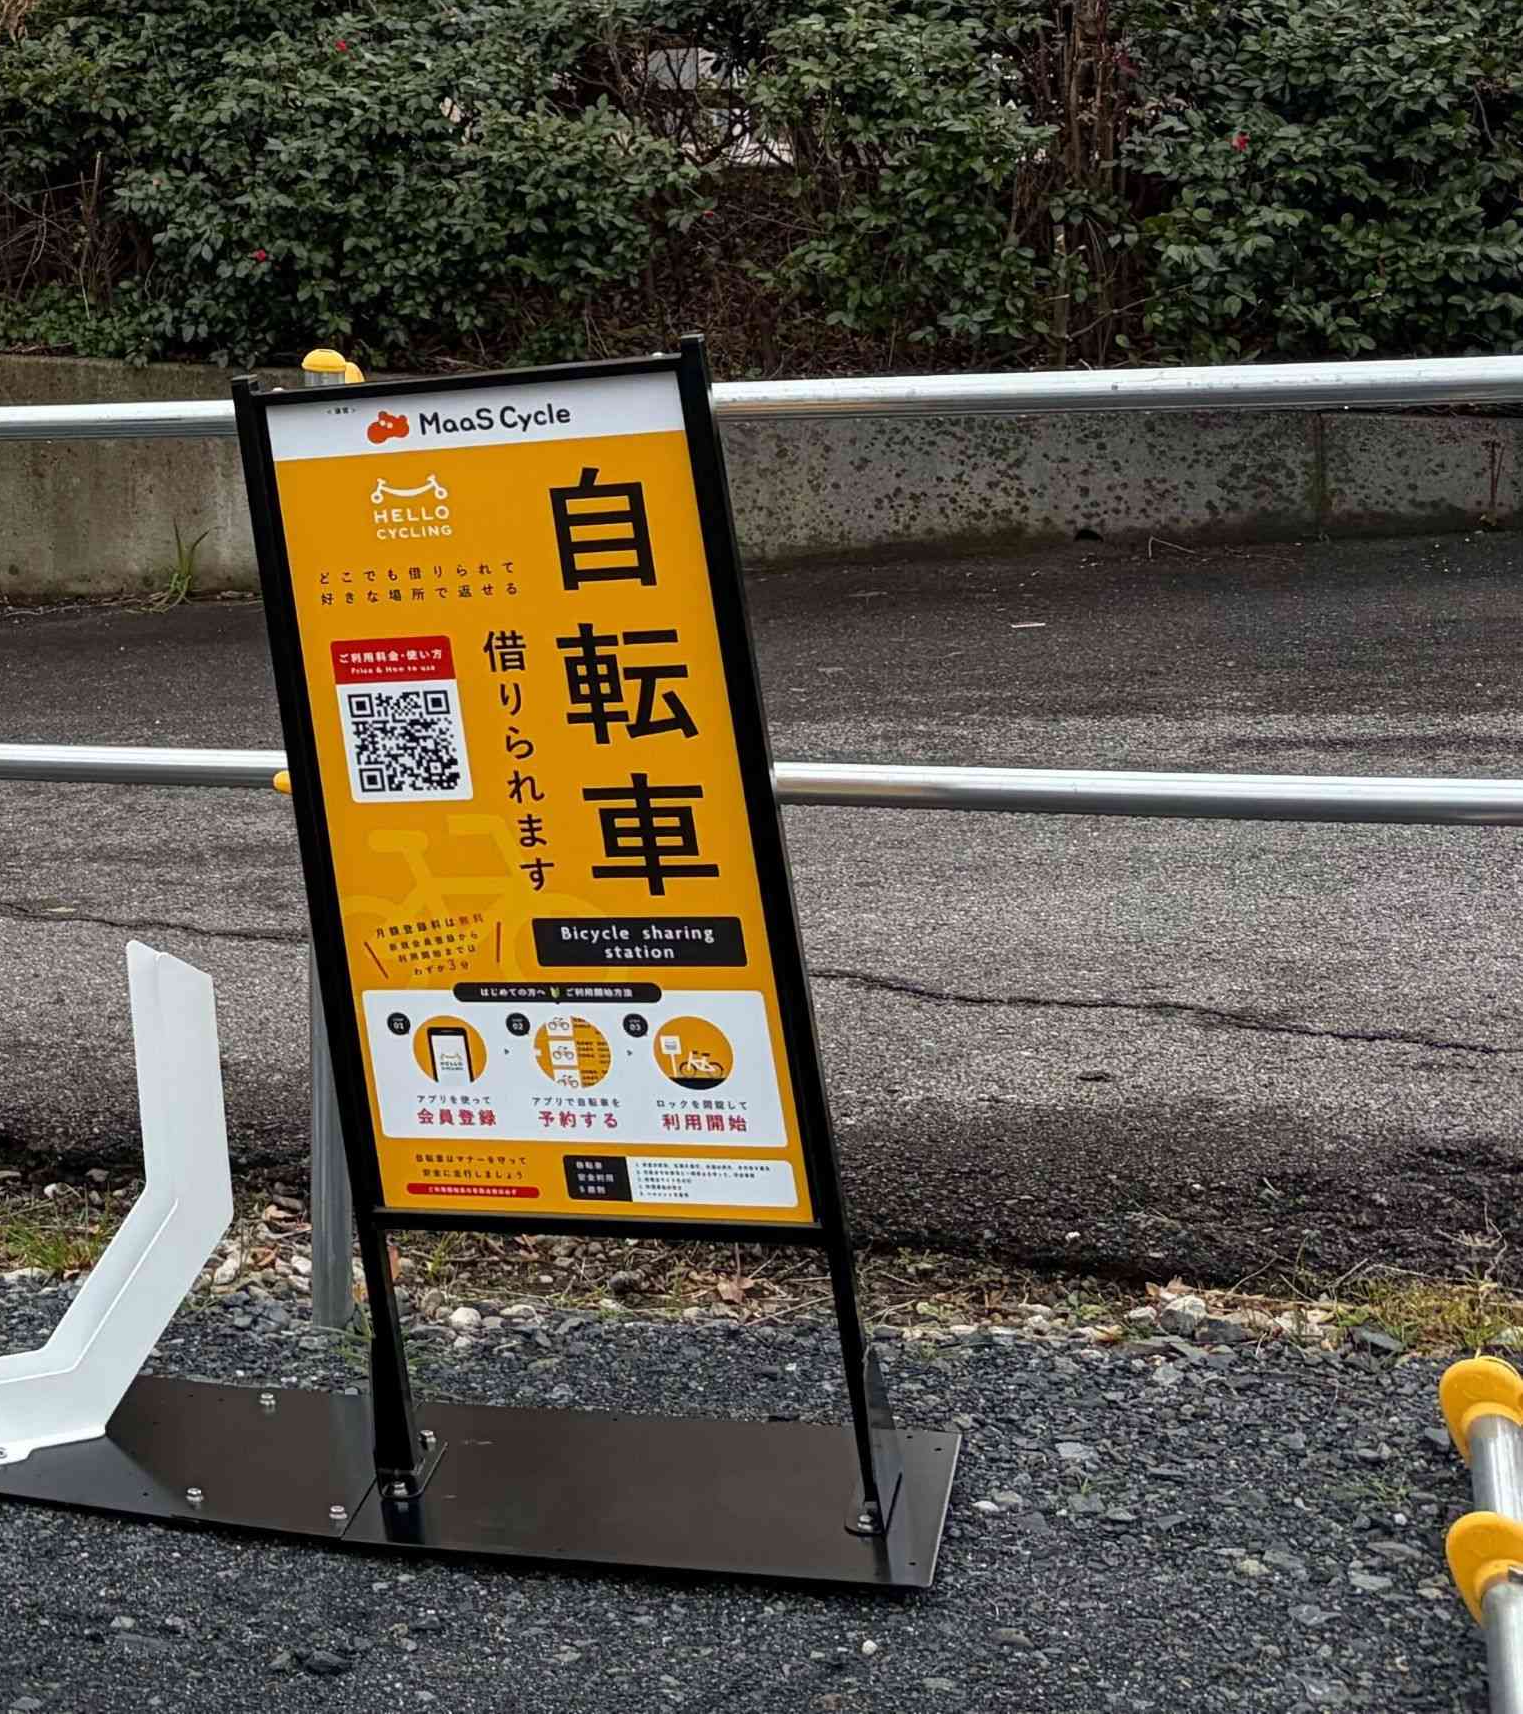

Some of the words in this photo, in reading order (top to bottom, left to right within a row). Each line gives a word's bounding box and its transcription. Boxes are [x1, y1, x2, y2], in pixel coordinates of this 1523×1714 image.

[419, 408, 494, 435] MaaS
[500, 403, 571, 432] Cycle
[374, 505, 449, 524] HELLO
[377, 525, 452, 540] CYCLING
[319, 562, 514, 584] どこでも借りられて
[321, 583, 518, 606] 好きな場所で返せる
[549, 467, 719, 895] 自転車
[483, 630, 554, 890] 借りられます
[561, 926, 630, 943] Bicycle
[642, 926, 715, 943] sharing
[604, 945, 675, 959] station
[417, 1108, 496, 1126] 会員登録
[538, 1111, 618, 1128] 予約する
[662, 1114, 748, 1132] 利用開始
